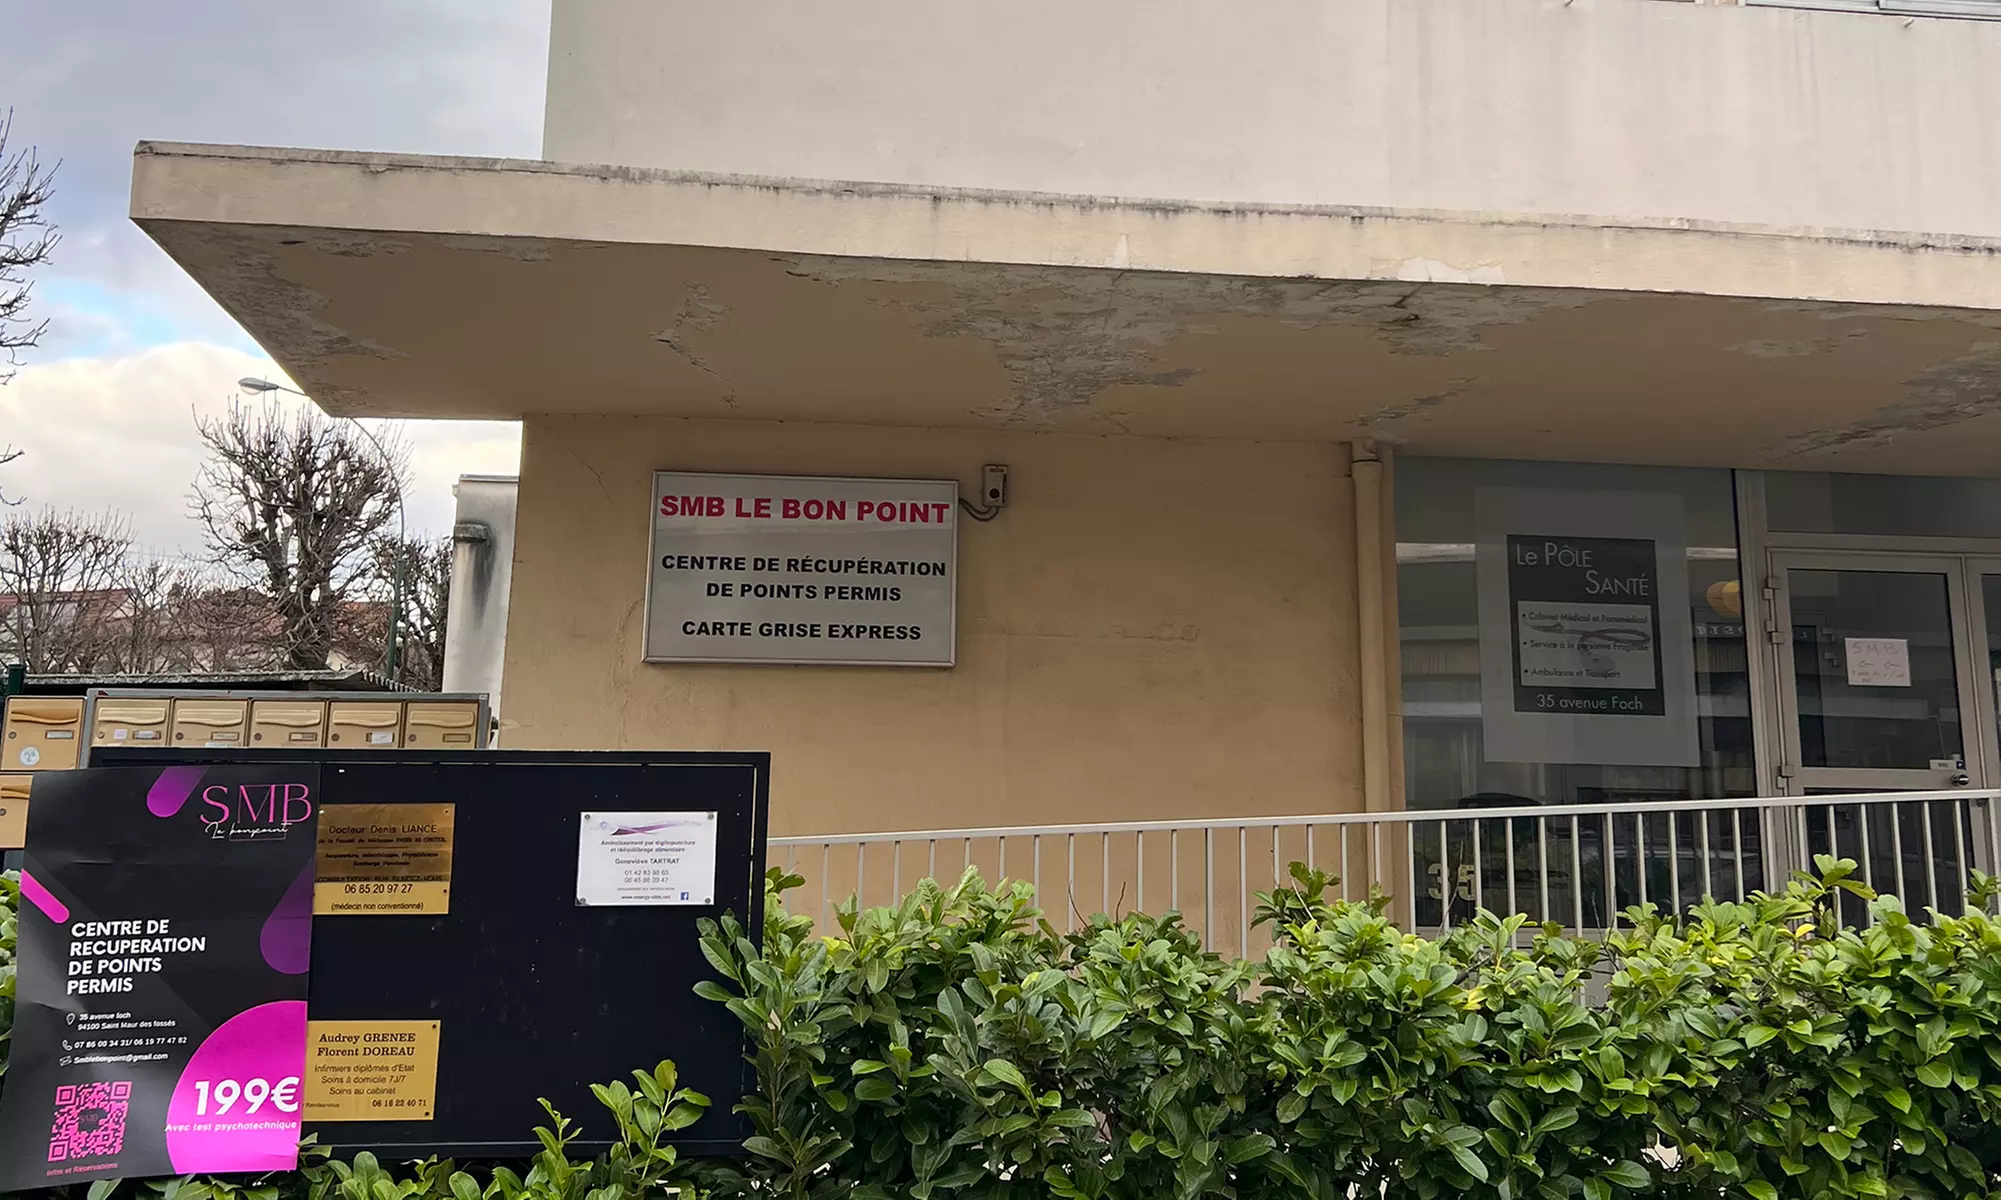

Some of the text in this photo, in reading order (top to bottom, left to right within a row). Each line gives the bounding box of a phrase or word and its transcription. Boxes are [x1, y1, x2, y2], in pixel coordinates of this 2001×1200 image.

[660, 495, 950, 524] SMB LE BON POINT
[1516, 544, 1538, 565] Le
[661, 555, 946, 576] CENTRE DE RÉCUPÉRATION
[706, 583, 902, 602] DE POINTS PERMIS
[682, 621, 922, 640] CARTE GRISE EXPRESS
[1530, 640, 1558, 649] Service
[1568, 641, 1574, 649] la
[1531, 668, 1574, 677] Ambulance
[1577, 668, 1584, 677] et
[1536, 694, 1642, 710] 35 avenue Foch
[200, 783, 312, 824] SMB
[329, 825, 437, 834] Docteur Denis LIANCE
[1428, 863, 1476, 901] 35
[344, 884, 413, 894] 06 85 20 97 27
[331, 902, 362, 911] (médecin
[377, 902, 424, 910] conventionné)
[72, 919, 170, 937] CENTRE DE
[70, 937, 206, 957] RECUPERATION
[68, 957, 162, 975] DE POINTS
[67, 977, 134, 994] PERMIS
[79, 1013, 89, 1021] 35
[116, 1011, 131, 1019] foch
[78, 1022, 100, 1031] 94100
[101, 1021, 119, 1030] Saint
[139, 1020, 152, 1028] des
[319, 1033, 416, 1044] Audrey GRENEE
[74, 1041, 85, 1049] 07
[317, 1047, 415, 1056] Florent DOREAU
[353, 1064, 389, 1073] diplômés
[321, 1076, 343, 1084] Soins
[194, 1076, 300, 1116] 199€
[329, 1087, 352, 1095] Soins
[395, 1099, 405, 1107] 22
[407, 1099, 416, 1107] 40
[418, 1099, 426, 1107] 71
[164, 1120, 297, 1132] Avec test psychotechnique
